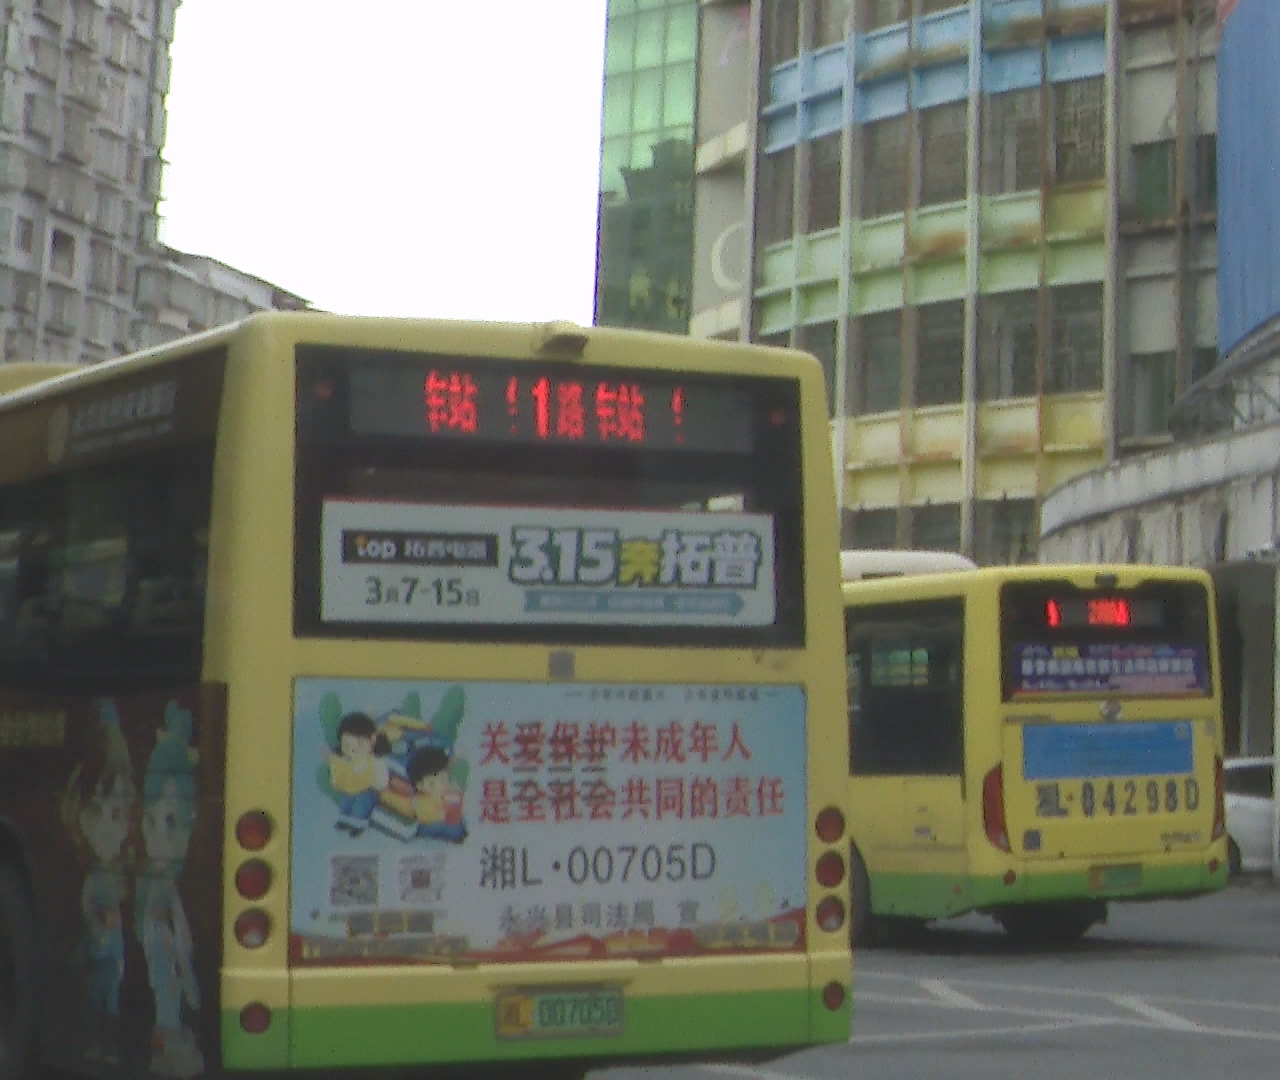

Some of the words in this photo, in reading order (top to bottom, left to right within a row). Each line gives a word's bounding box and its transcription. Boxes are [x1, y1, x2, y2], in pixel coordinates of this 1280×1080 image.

[478, 720, 752, 767] 关爱保护未成年人
[478, 775, 788, 825] 是全社会共同的责任
